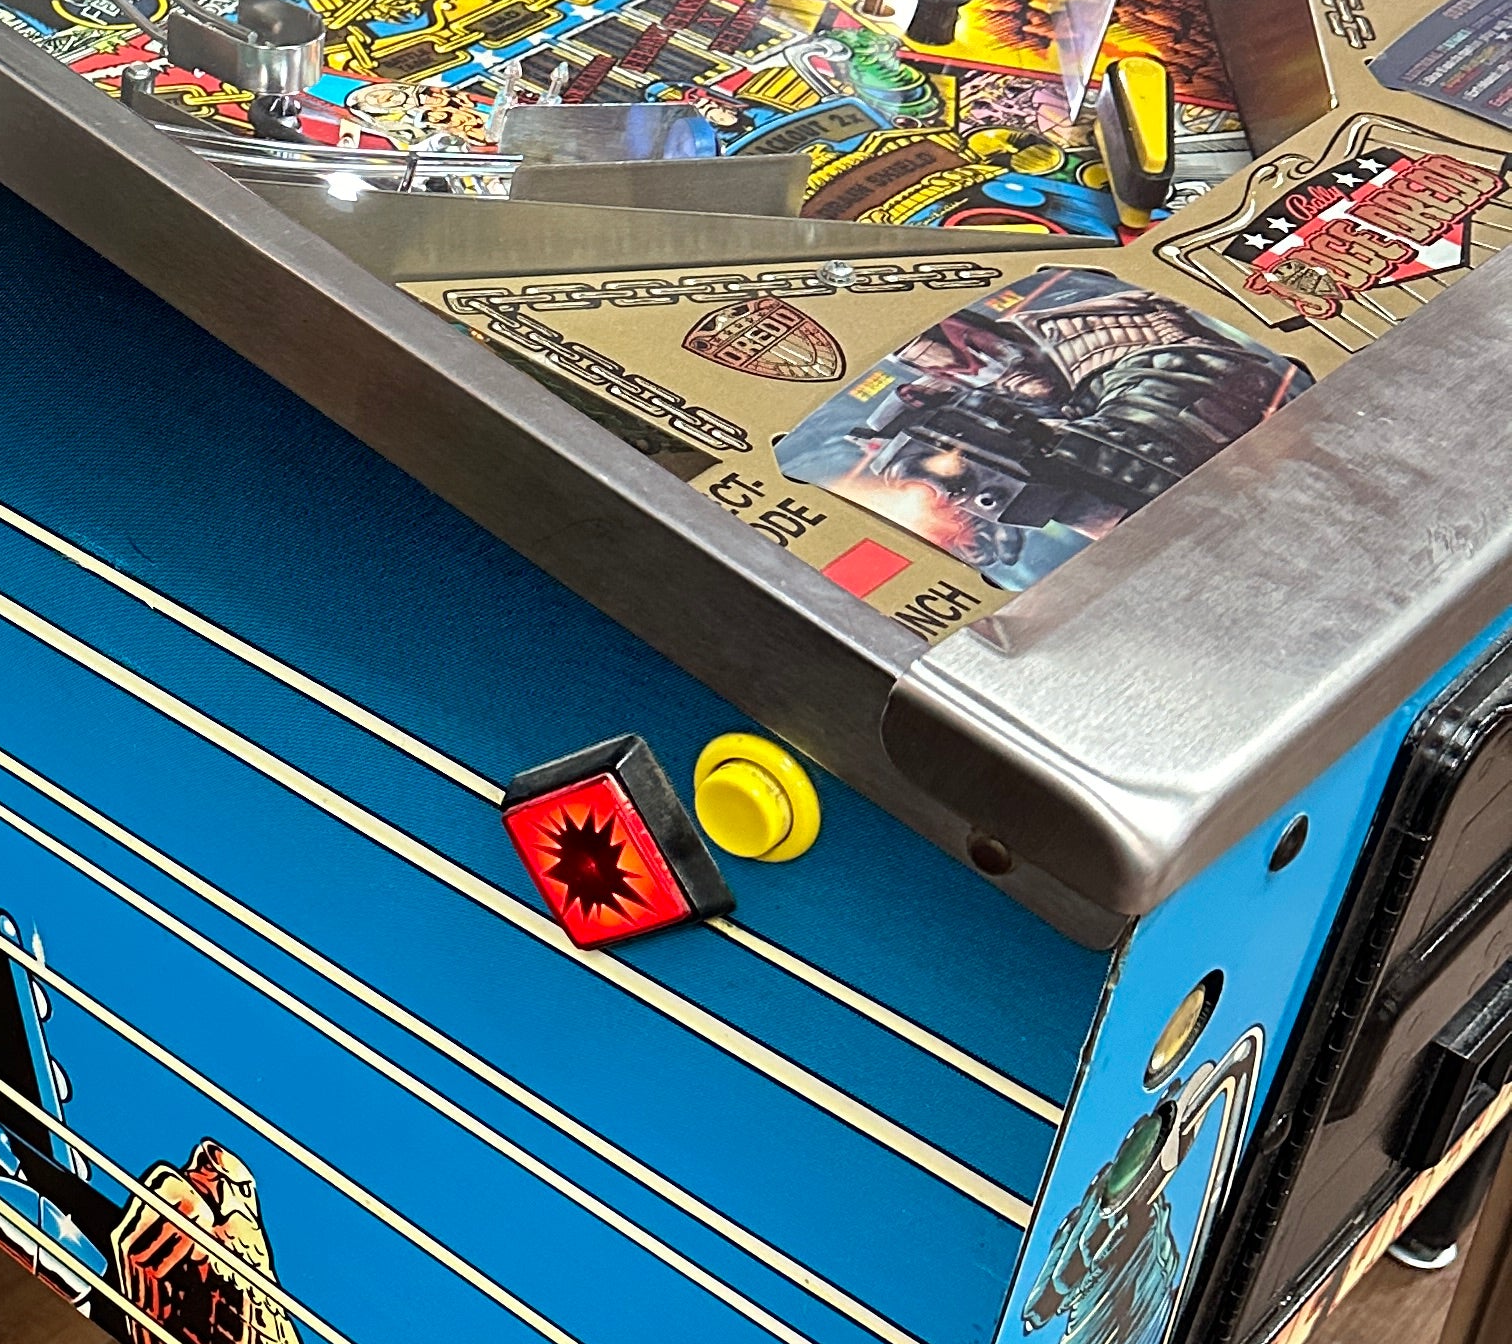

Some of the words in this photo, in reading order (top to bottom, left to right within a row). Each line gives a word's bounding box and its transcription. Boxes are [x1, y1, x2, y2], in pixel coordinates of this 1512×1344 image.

[754, 120, 830, 156] ACKOUT
[1285, 185, 1350, 221] Bally
[1243, 218, 1418, 320] JDGE
[1344, 153, 1504, 246] DREDD
[714, 306, 805, 366] DREDD
